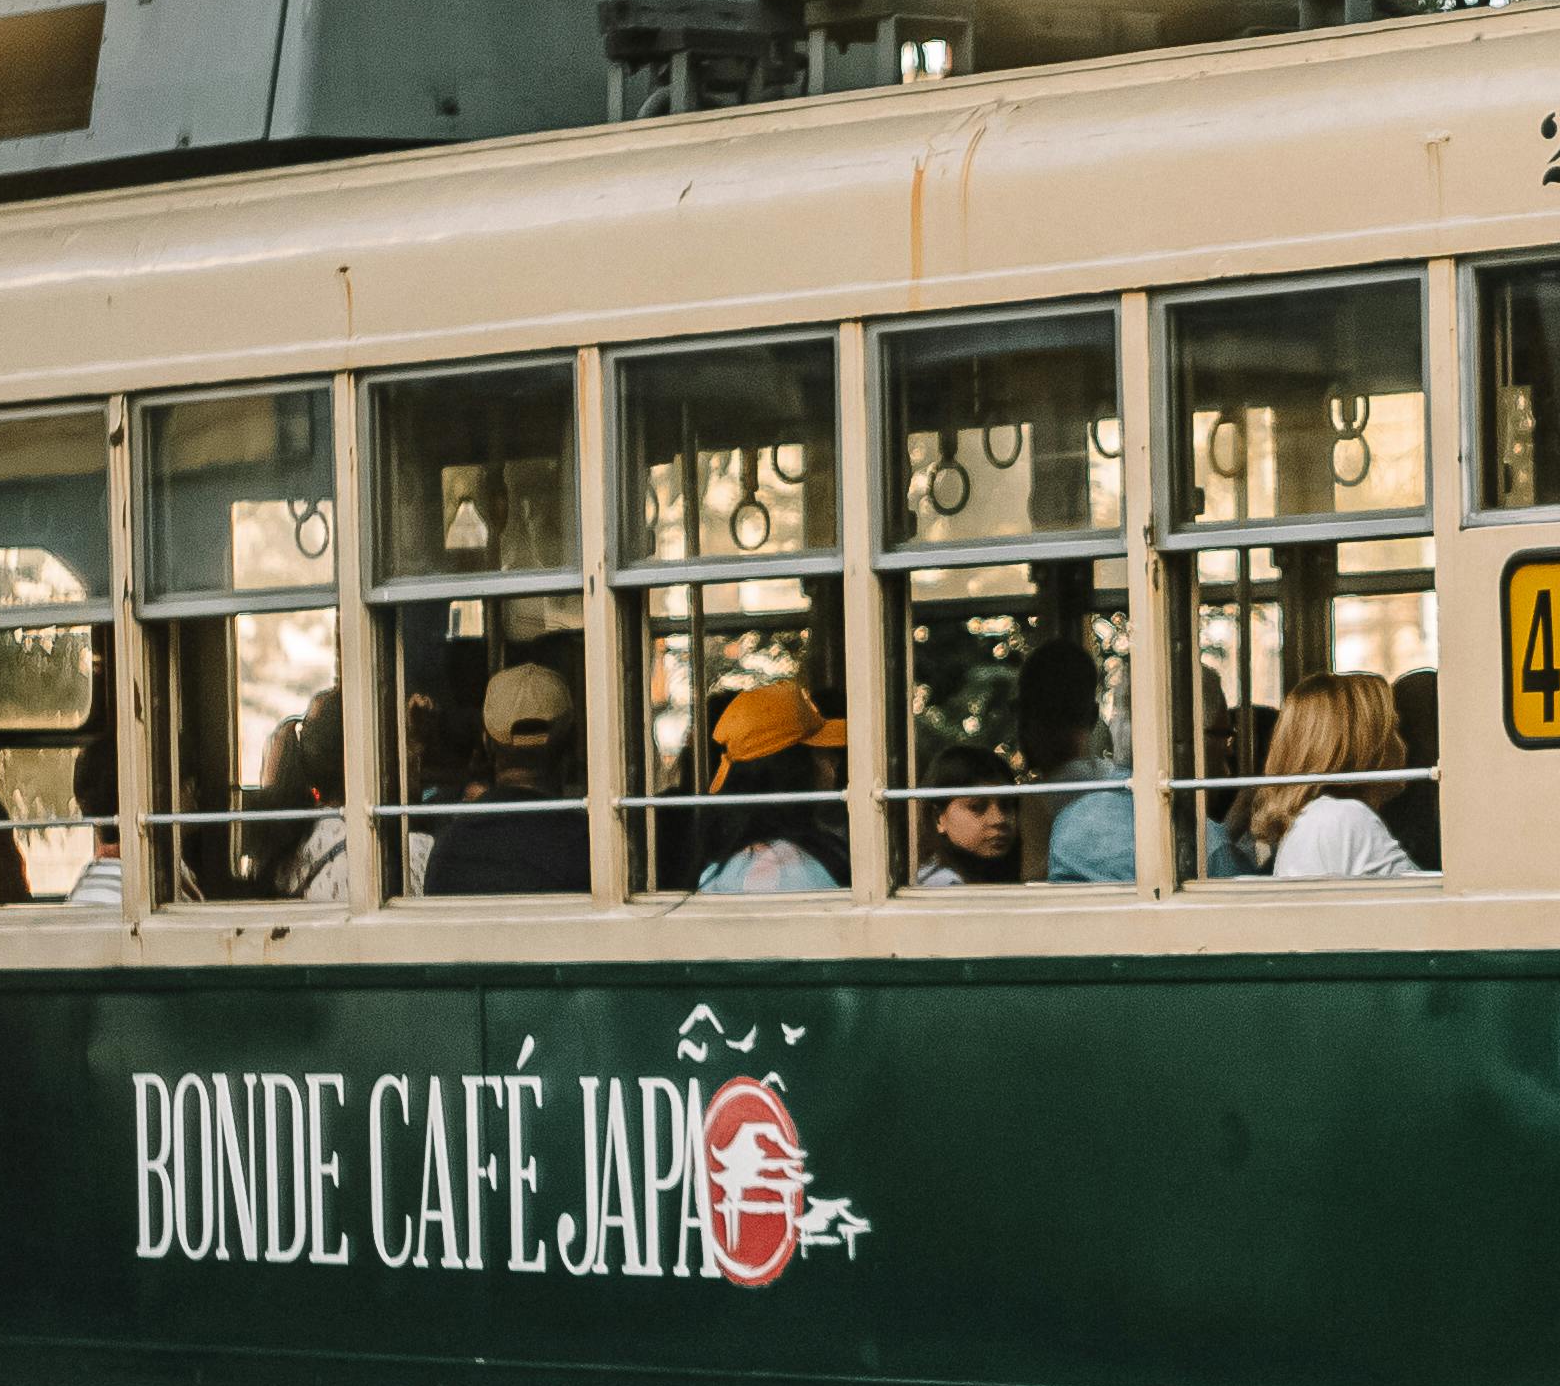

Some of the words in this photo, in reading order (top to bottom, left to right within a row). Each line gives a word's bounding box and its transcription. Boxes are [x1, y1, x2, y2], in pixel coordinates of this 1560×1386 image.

[1522, 588, 1560, 723] 4
[132, 1071, 350, 1265] BONDE
[369, 1033, 547, 1273] CAFÉ
